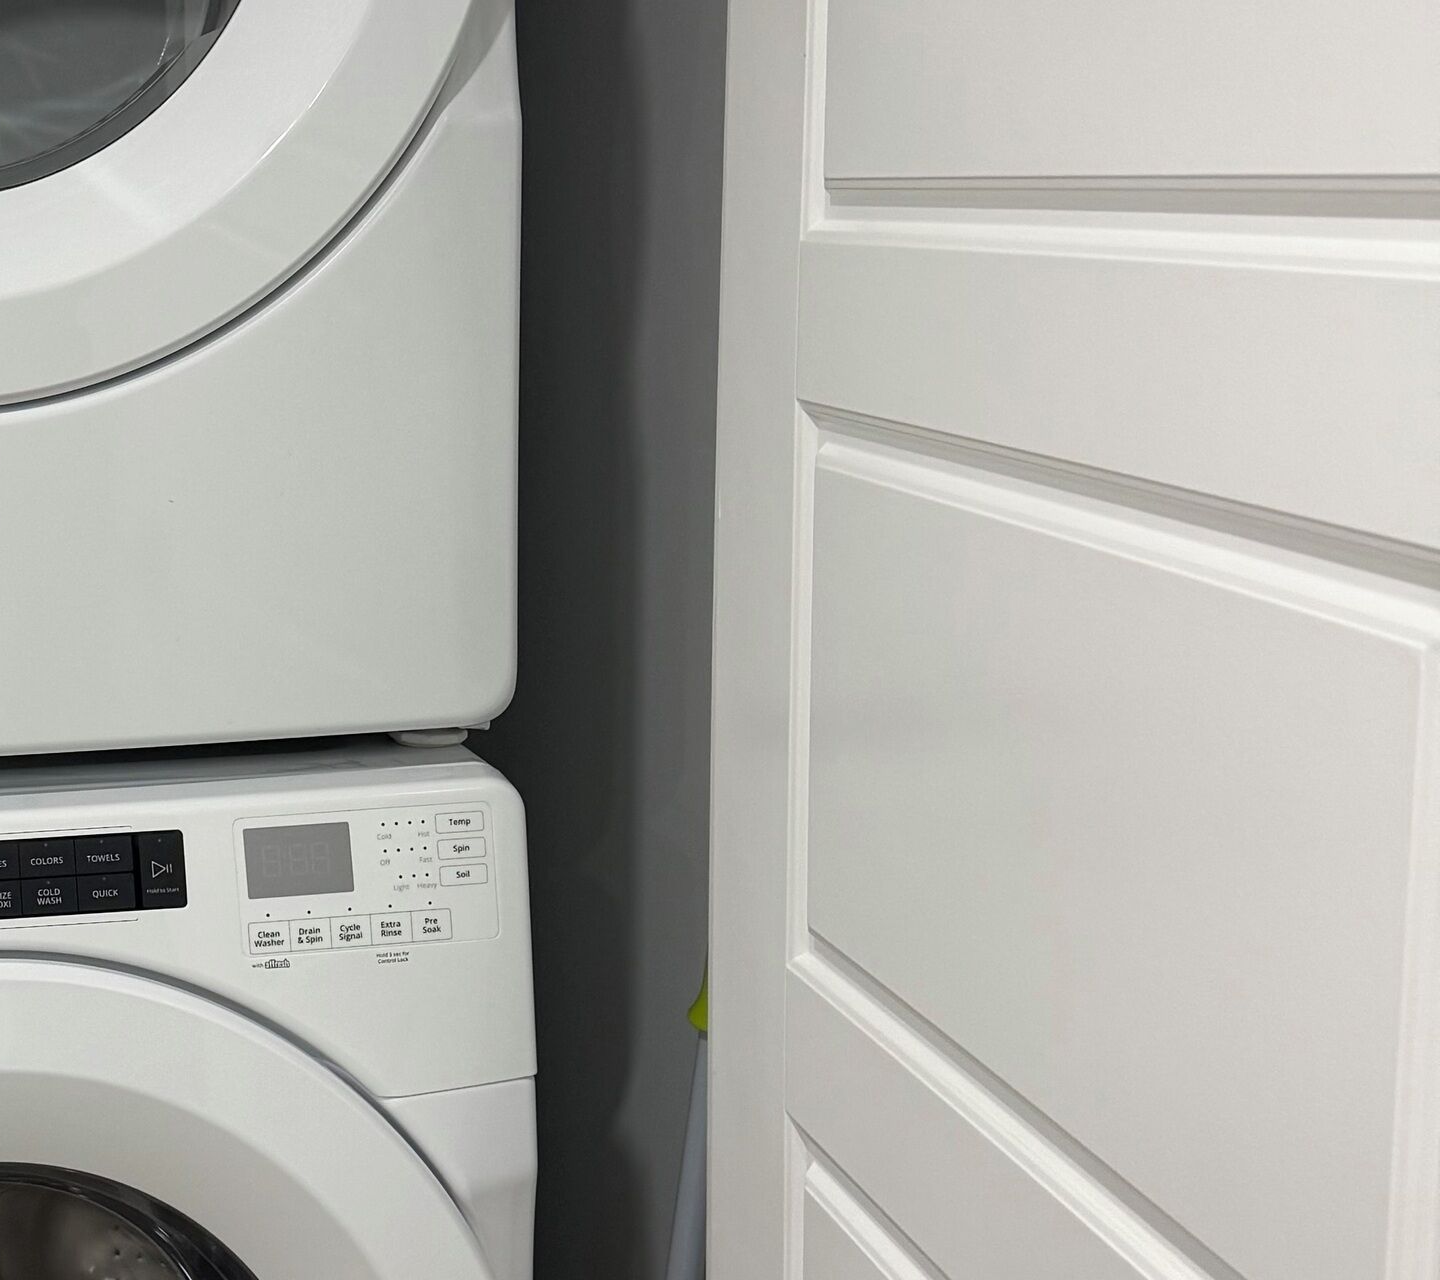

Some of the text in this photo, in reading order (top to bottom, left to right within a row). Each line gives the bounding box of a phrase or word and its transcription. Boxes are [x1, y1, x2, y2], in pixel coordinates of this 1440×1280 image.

[448, 818, 471, 827] Temp
[452, 844, 470, 854] Spin
[30, 856, 64, 866] COLORS
[86, 853, 120, 863] TOWELS
[455, 870, 471, 879] Soil
[37, 888, 61, 898] COLD
[92, 888, 119, 899] QUICK
[37, 896, 62, 906] WASH
[380, 920, 401, 929] Extra
[424, 917, 438, 926] Pre
[298, 926, 321, 936] Drain
[339, 923, 361, 934] Cycle
[380, 928, 402, 937] Rinse
[422, 925, 442, 934] Soak
[257, 930, 281, 939] Clean
[297, 934, 324, 945] & Spin
[338, 931, 363, 942] Signal
[254, 938, 285, 948] Washer
